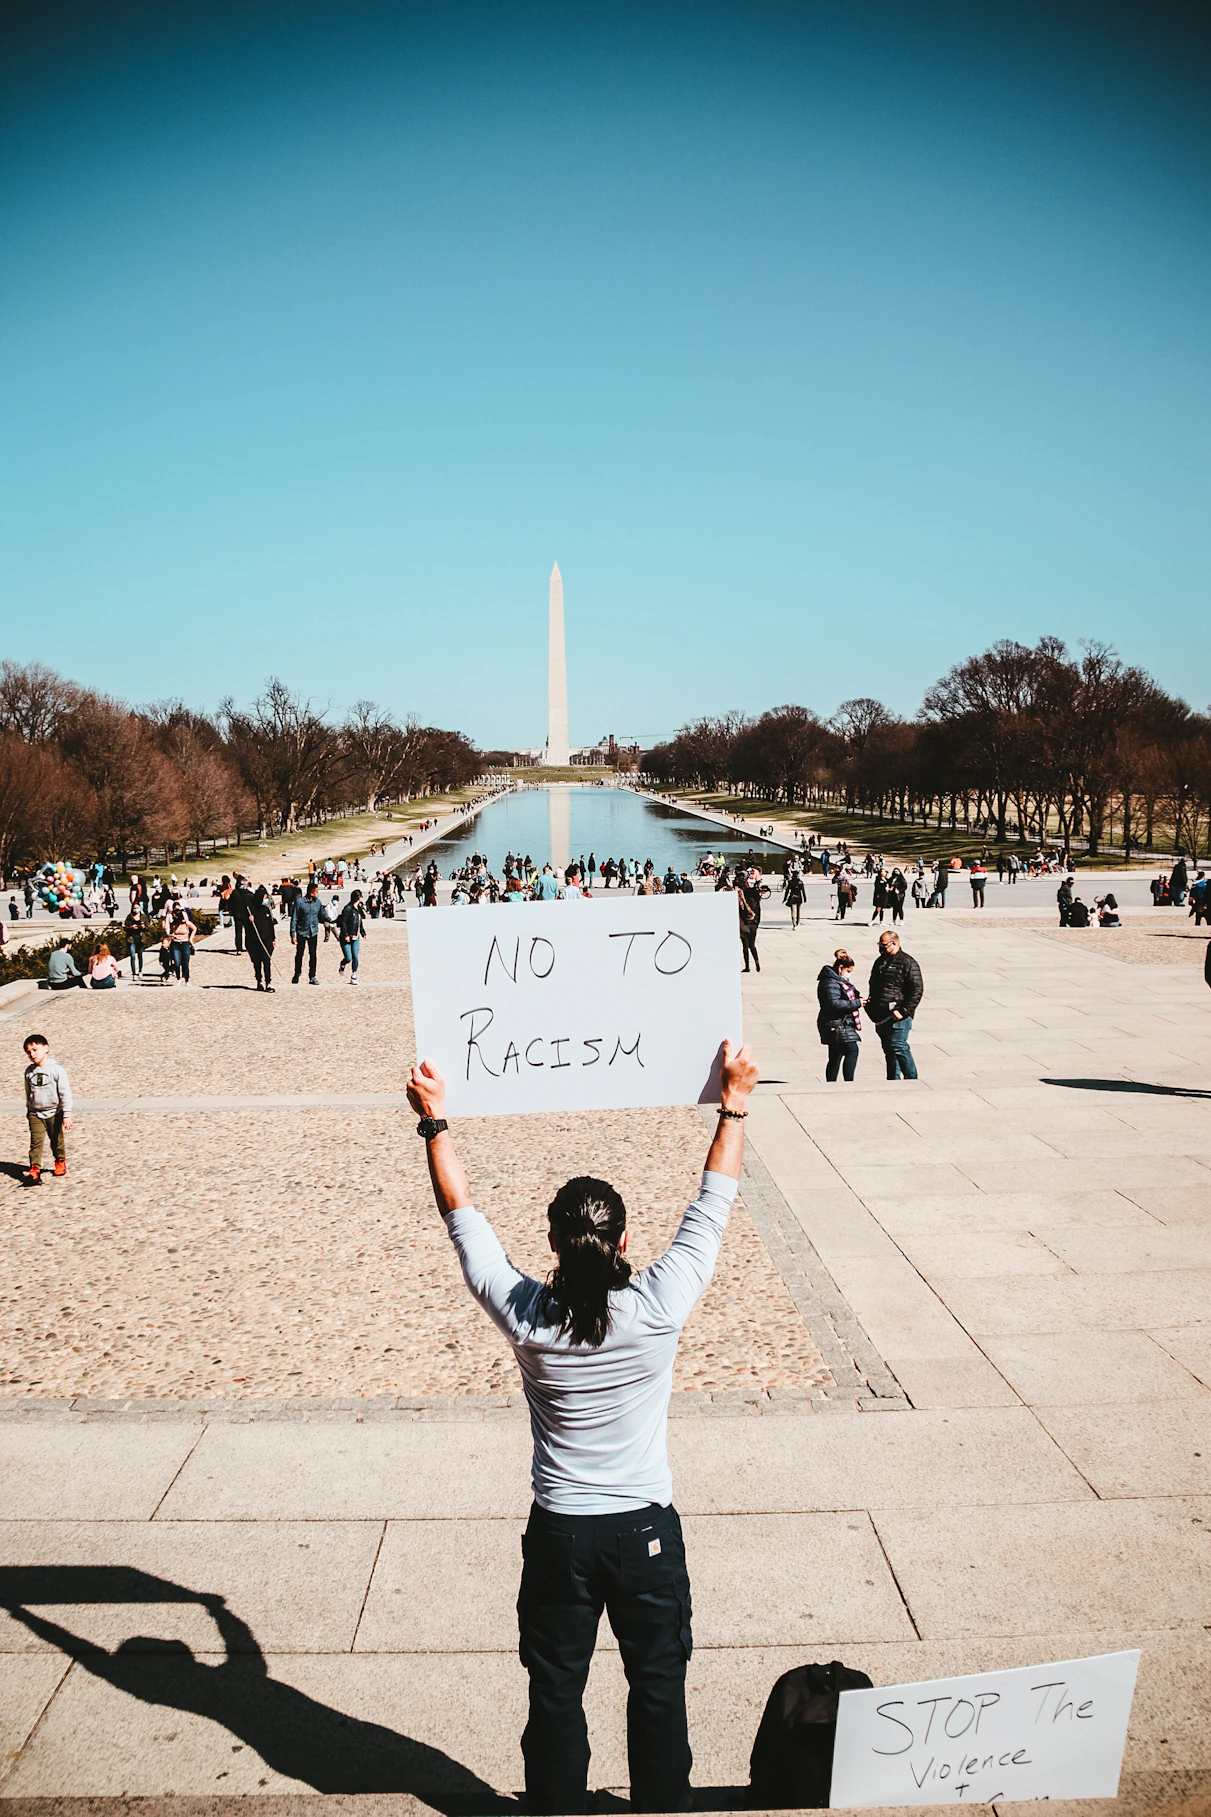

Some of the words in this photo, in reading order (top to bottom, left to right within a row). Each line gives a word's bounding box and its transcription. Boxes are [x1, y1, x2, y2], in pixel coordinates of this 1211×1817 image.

[484, 935, 555, 986] NO
[608, 930, 692, 976] TO
[460, 1007, 645, 1081] RACISM
[871, 1692, 1001, 1755] STOP
[1030, 1682, 1094, 1725] The
[909, 1749, 1033, 1788] Violence
